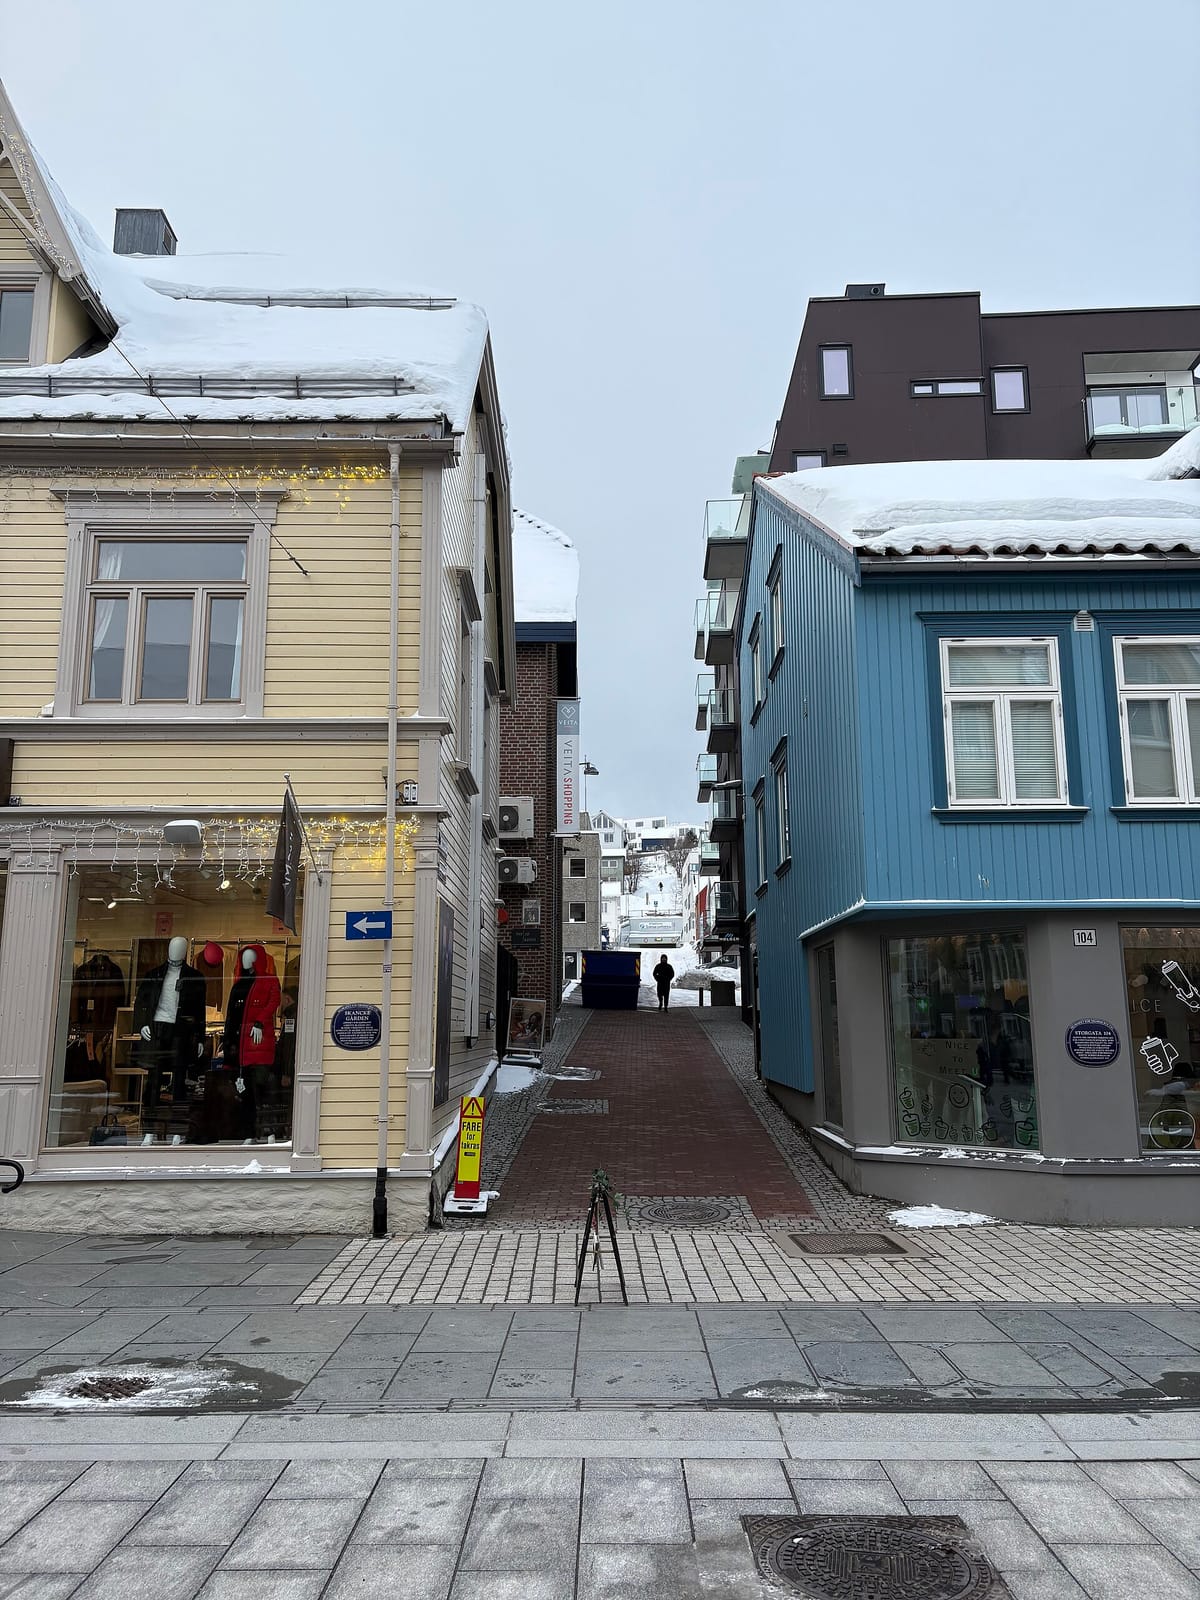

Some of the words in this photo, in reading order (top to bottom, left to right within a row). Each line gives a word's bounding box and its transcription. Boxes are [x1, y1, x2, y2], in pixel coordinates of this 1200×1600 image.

[1076, 932, 1093, 943] 104
[462, 1122, 482, 1131] FARE
[466, 1132, 476, 1140] for
